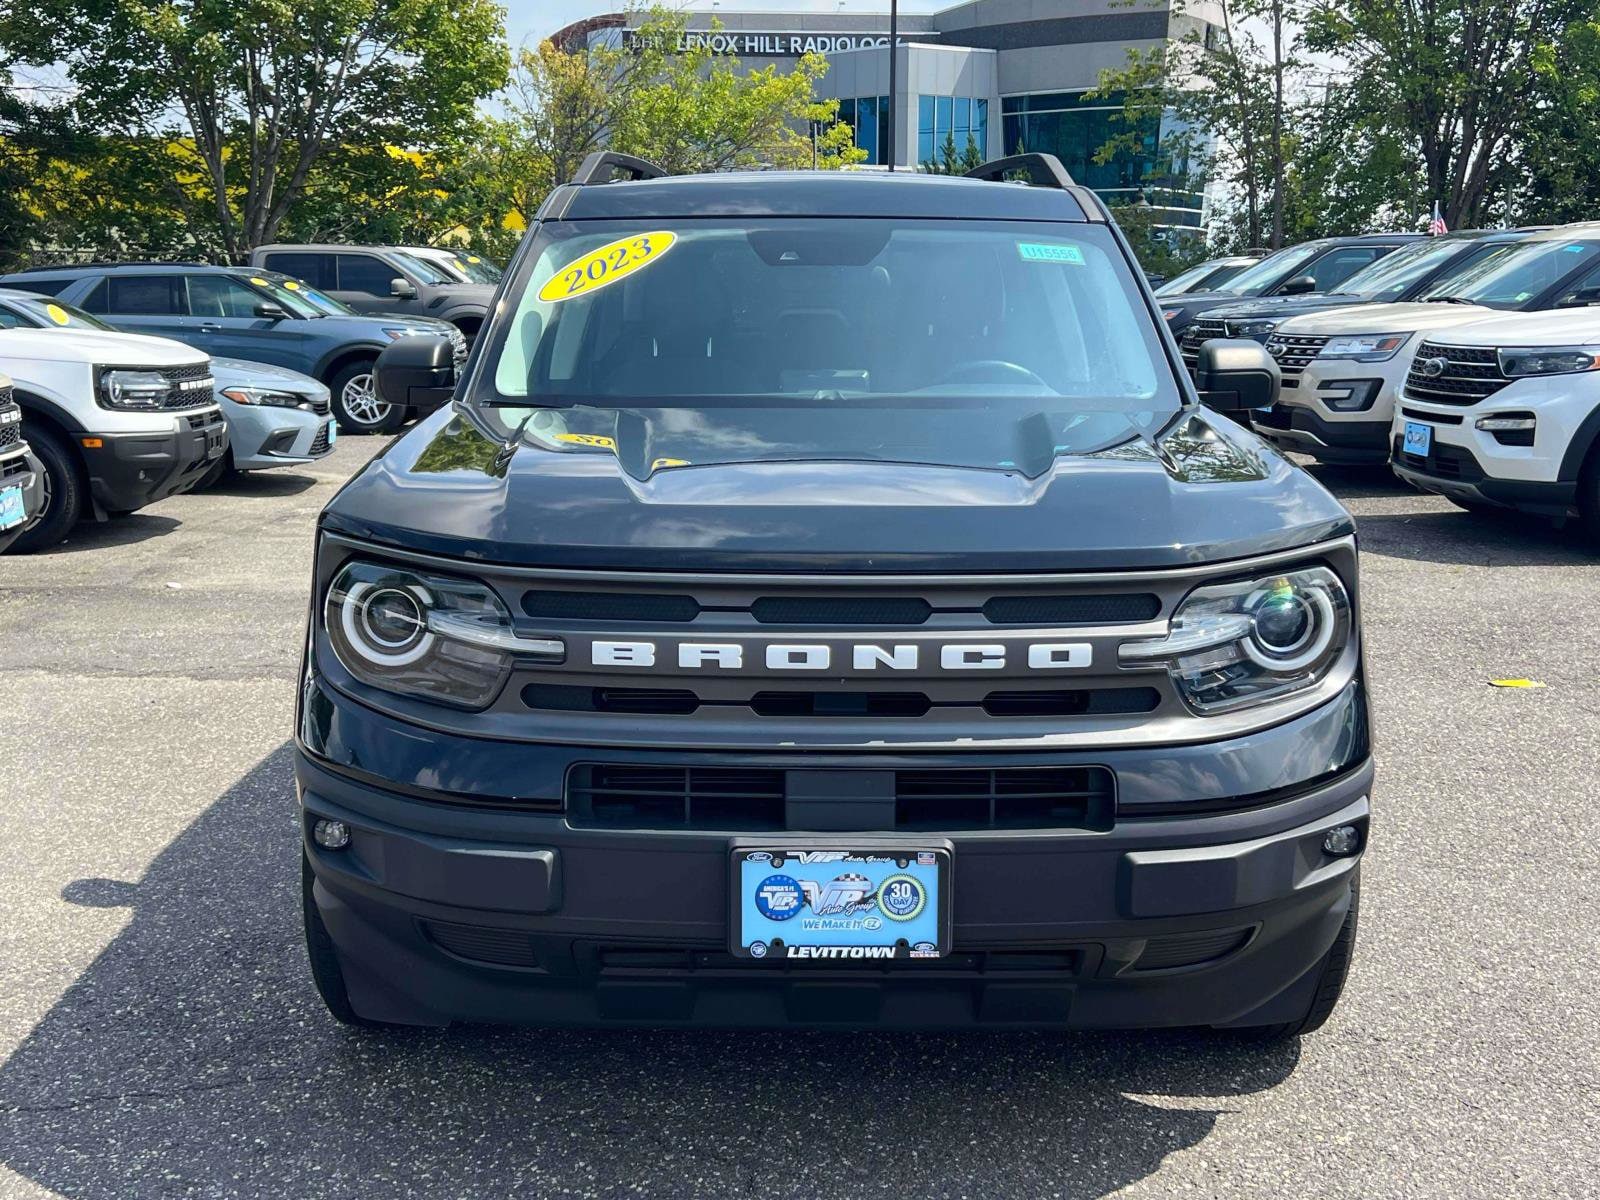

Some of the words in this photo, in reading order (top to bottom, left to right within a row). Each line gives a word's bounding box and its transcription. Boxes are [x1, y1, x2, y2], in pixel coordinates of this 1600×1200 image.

[677, 35, 738, 52] LENOX
[745, 37, 784, 53] HILL
[564, 238, 652, 293] 2023
[591, 640, 1093, 670] BRONCO
[844, 855, 865, 863] Auto
[866, 855, 891, 864] Group
[798, 880, 871, 915] VIP
[891, 883, 910, 899] 30
[819, 903, 845, 916] Auto
[846, 901, 876, 916] Group
[787, 946, 896, 959] LEVITTOWN
